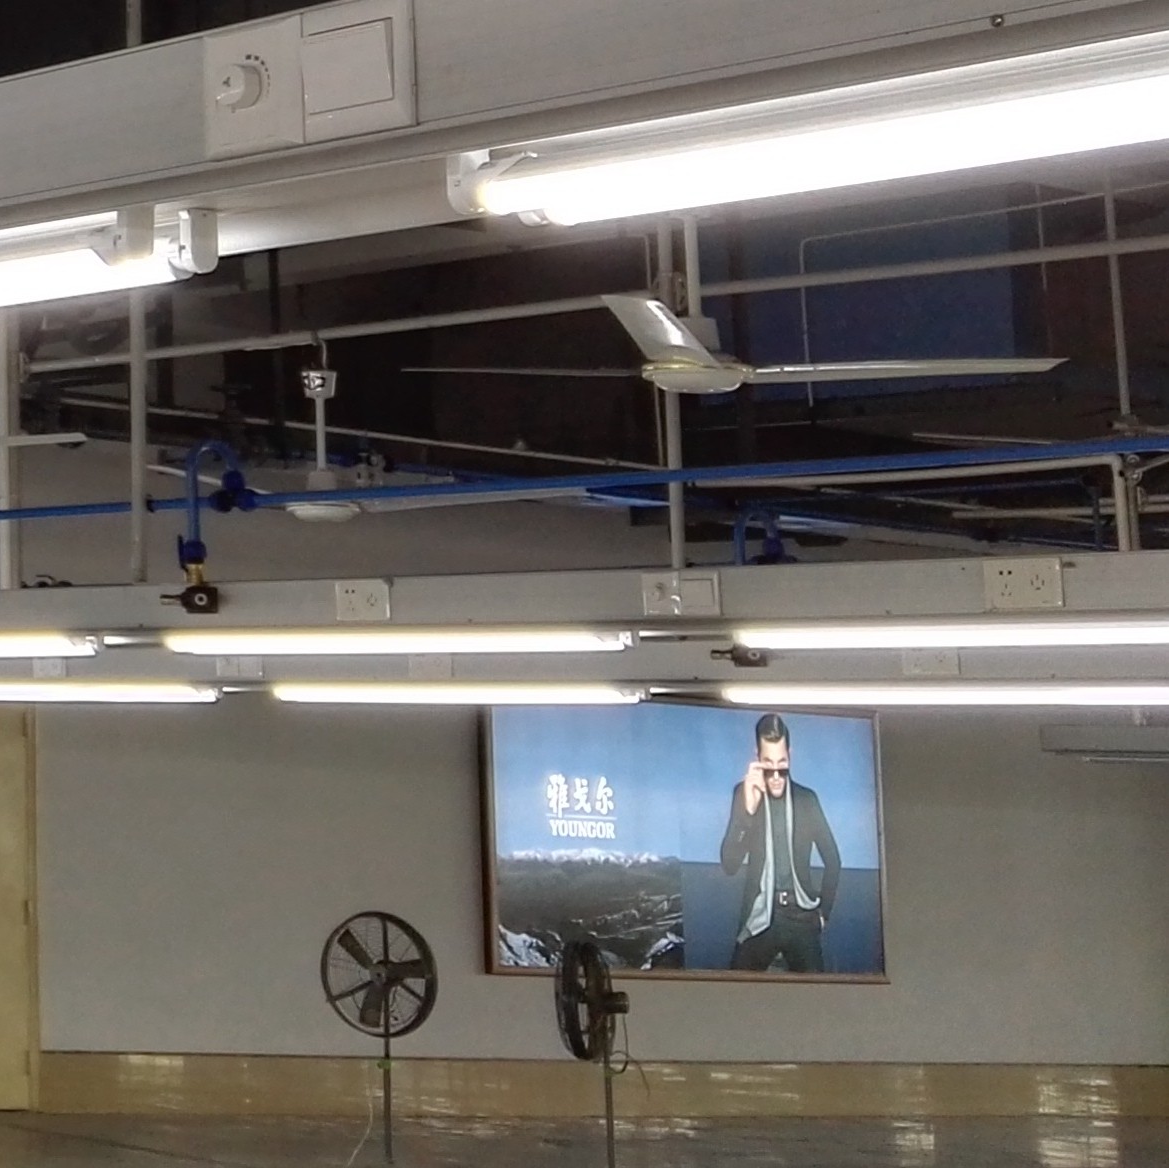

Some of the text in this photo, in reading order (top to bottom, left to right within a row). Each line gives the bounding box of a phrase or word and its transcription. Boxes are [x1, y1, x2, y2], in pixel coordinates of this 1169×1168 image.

[547, 774, 614, 817] 雅戈尔
[549, 819, 615, 839] YOUNGOR
